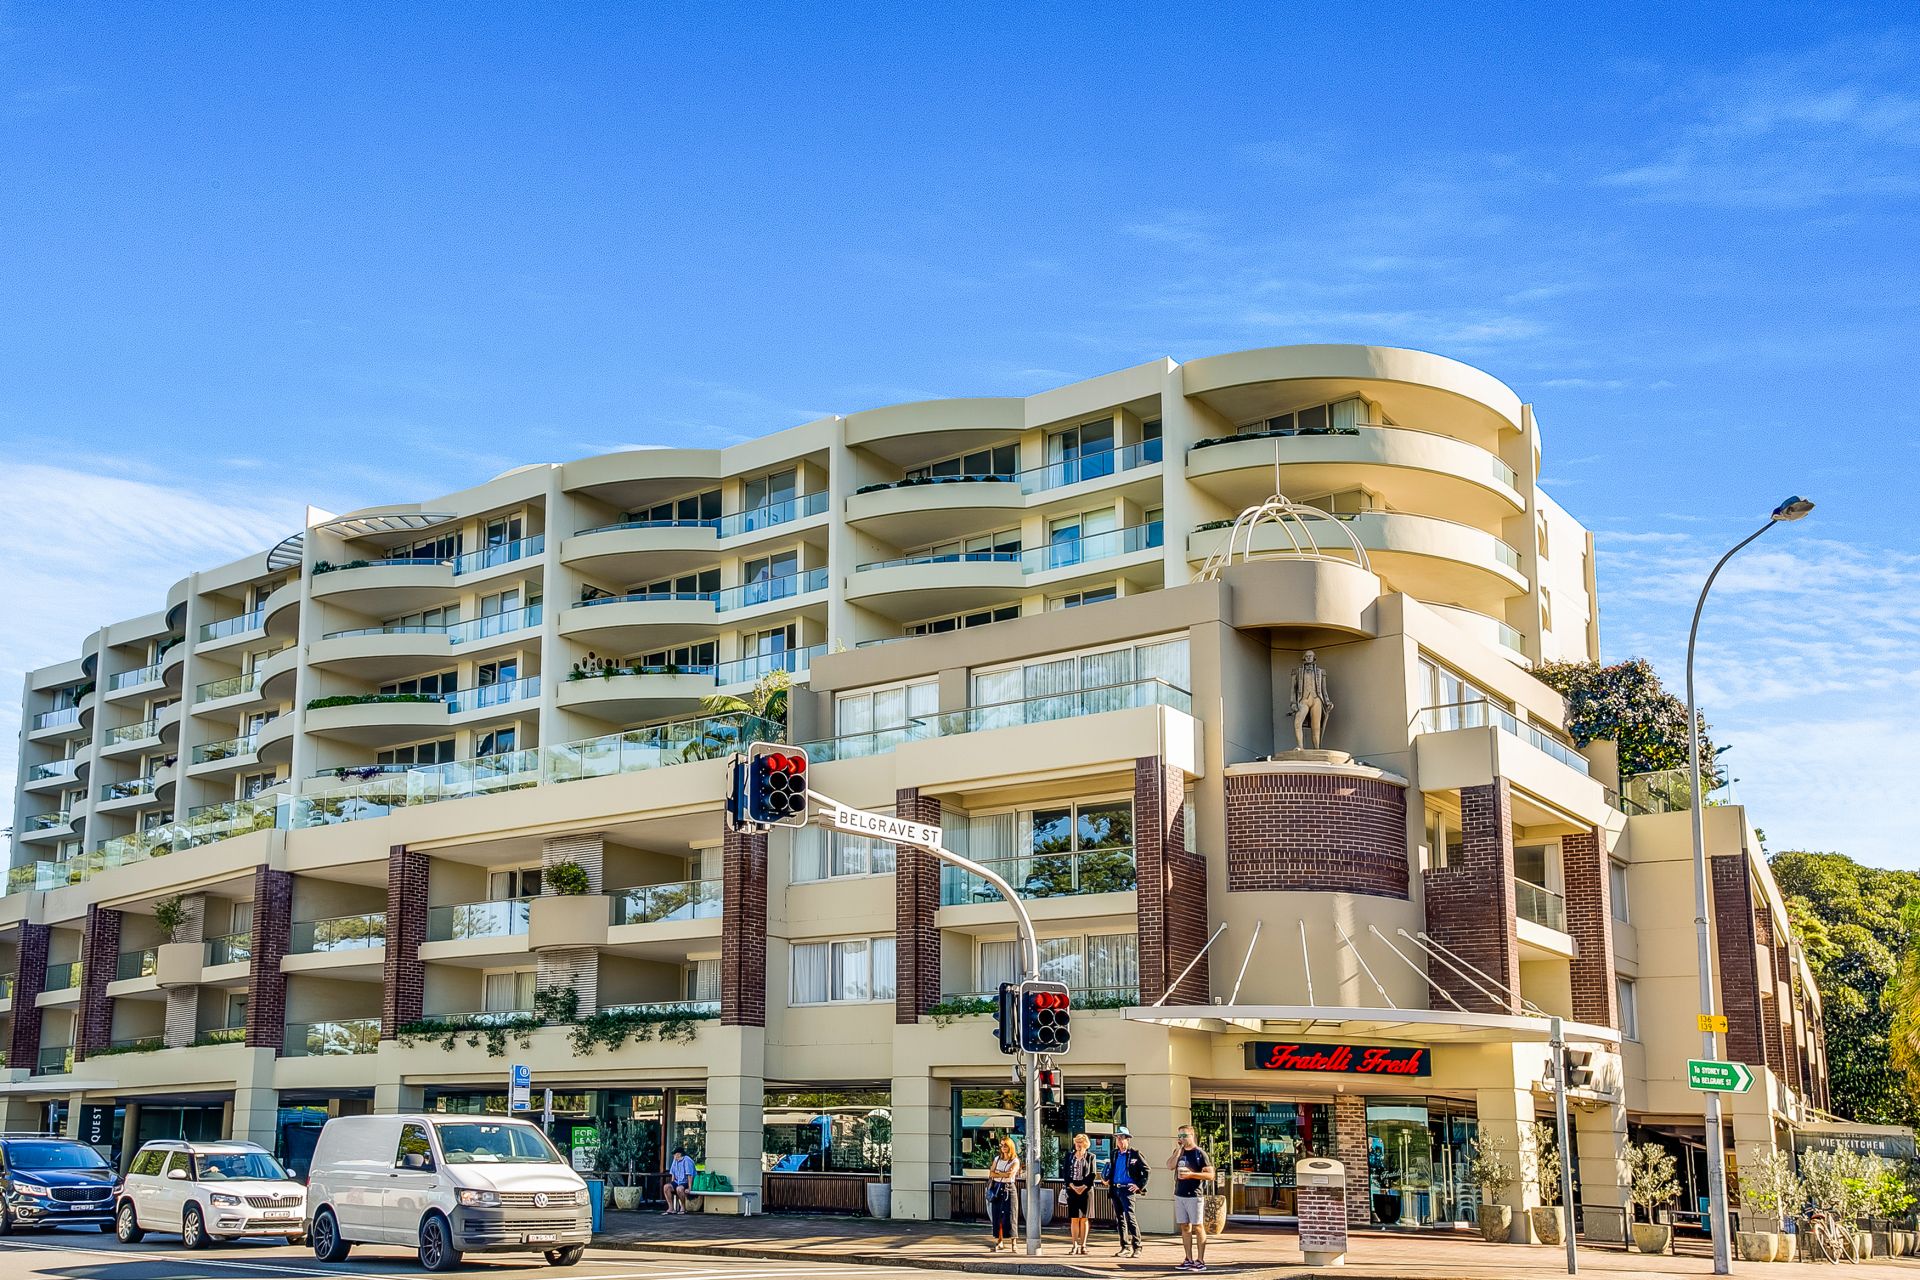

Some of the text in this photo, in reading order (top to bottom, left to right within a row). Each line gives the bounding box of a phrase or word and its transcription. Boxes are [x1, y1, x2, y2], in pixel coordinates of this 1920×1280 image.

[840, 811, 938, 843] BELGRAVE ST
[1700, 1015, 1712, 1023] 136
[1700, 1023, 1713, 1031] 139
[1264, 1045, 1423, 1074] Fratelli Fresh
[1693, 1065, 1729, 1076] To SYDNEY RD
[1691, 1075, 1732, 1086] Via BELGRAVE ST
[90, 1107, 102, 1143] QUEST
[574, 1129, 593, 1137] FOR
[1820, 1138, 1885, 1150] VIET KITCHEN
